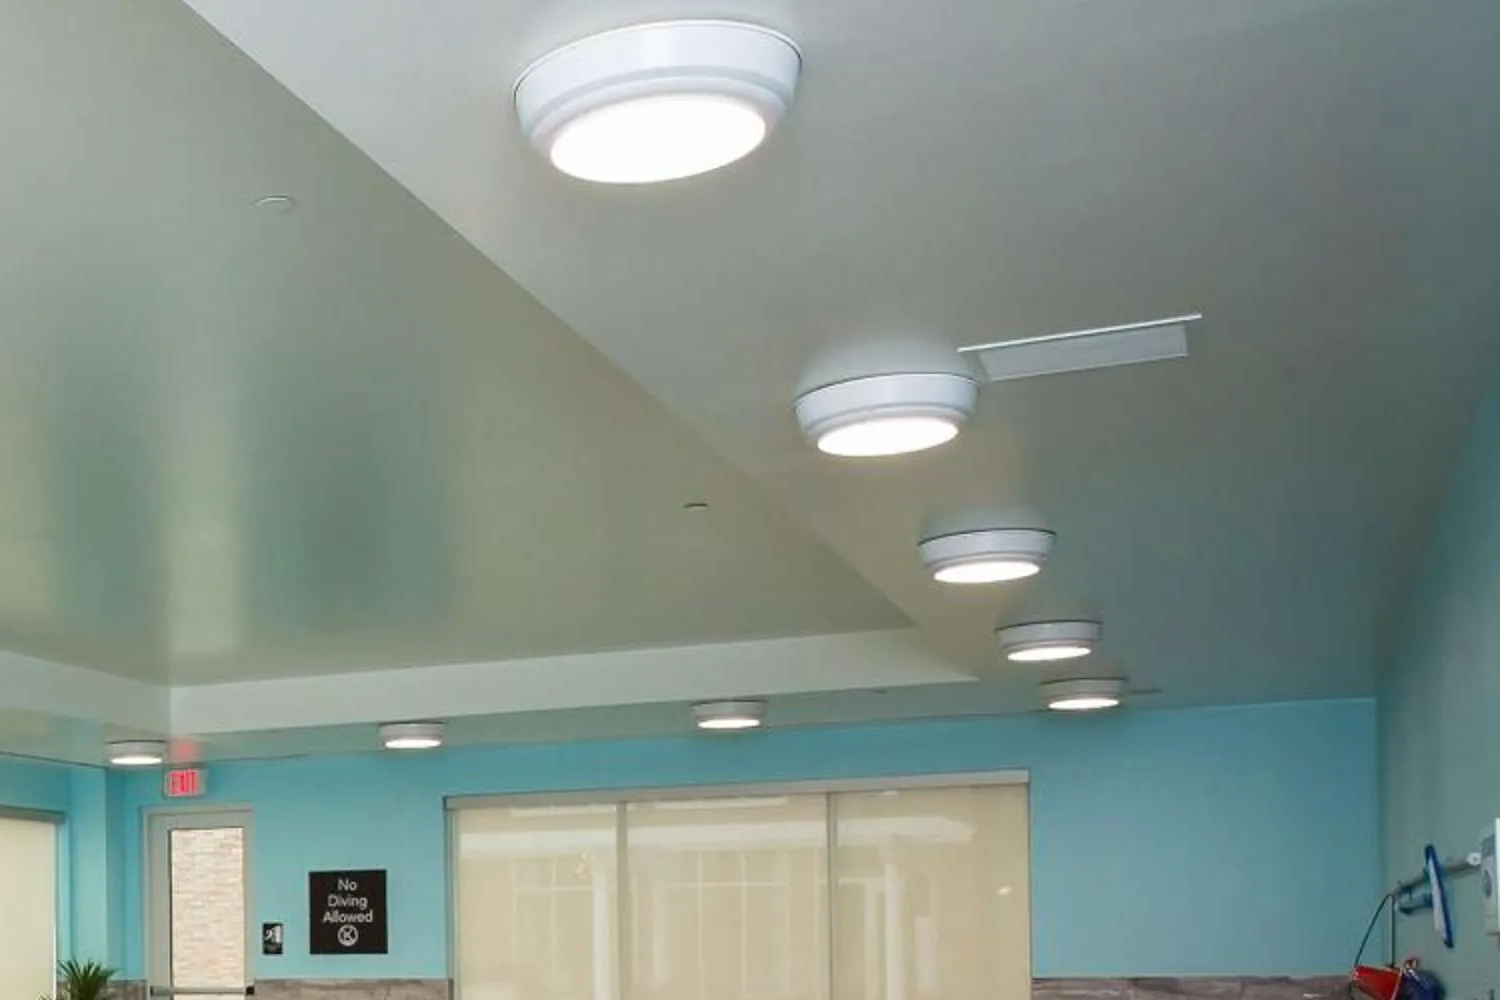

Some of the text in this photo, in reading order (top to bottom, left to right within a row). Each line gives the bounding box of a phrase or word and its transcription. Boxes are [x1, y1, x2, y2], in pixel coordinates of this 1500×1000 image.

[171, 771, 197, 795] EXIT
[337, 878, 358, 891] No
[327, 894, 368, 910] Diving
[322, 909, 373, 923] Allowed
